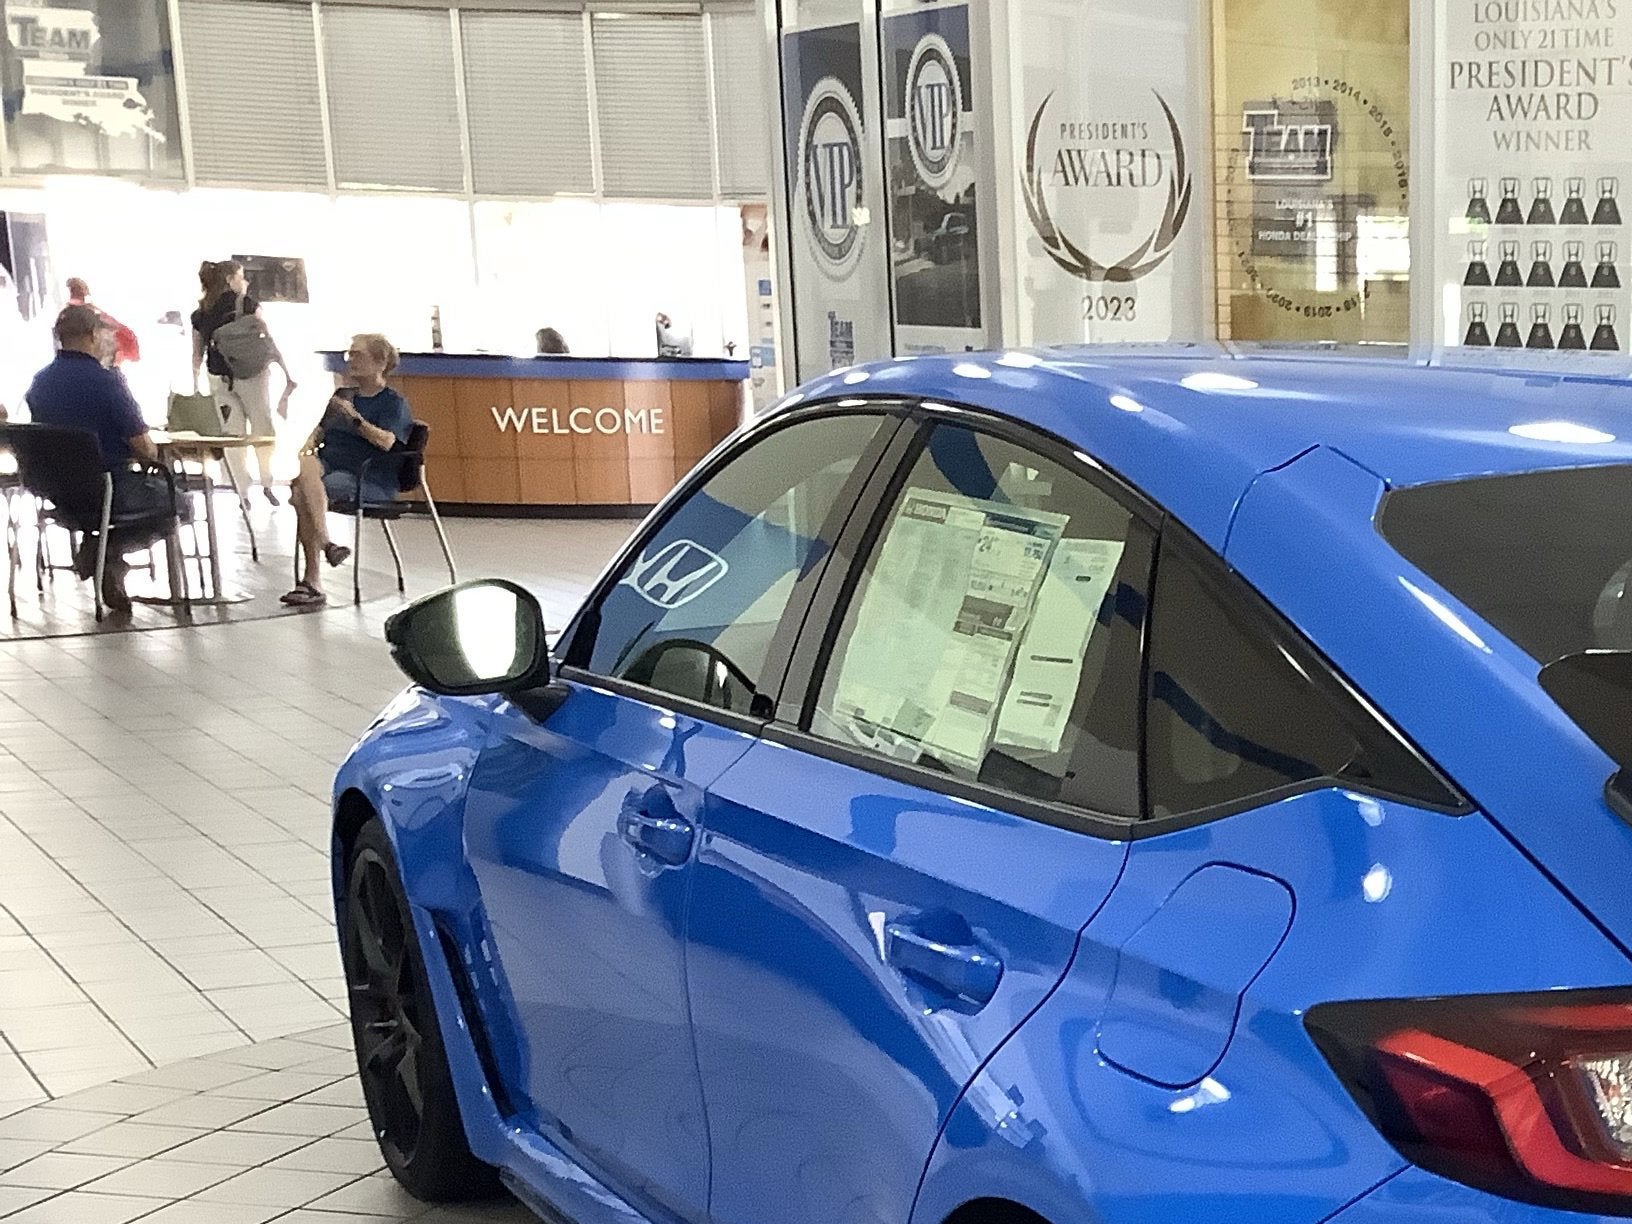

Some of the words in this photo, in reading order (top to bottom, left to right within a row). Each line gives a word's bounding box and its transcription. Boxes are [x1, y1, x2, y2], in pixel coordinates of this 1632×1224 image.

[10, 16, 90, 49] TEAM
[1474, 30, 1532, 51] ONLY
[1560, 27, 1614, 49] TIME
[915, 83, 951, 150] VIP
[1486, 92, 1600, 122] AWARD
[1060, 122, 1149, 140] PRESIDENT'S
[1493, 129, 1593, 152] WINNER
[1050, 148, 1163, 188] AWARD
[810, 142, 857, 229] VIP
[1296, 211, 1314, 227] #1
[1081, 294, 1136, 322] 2023
[491, 407, 665, 434] WELCOME
